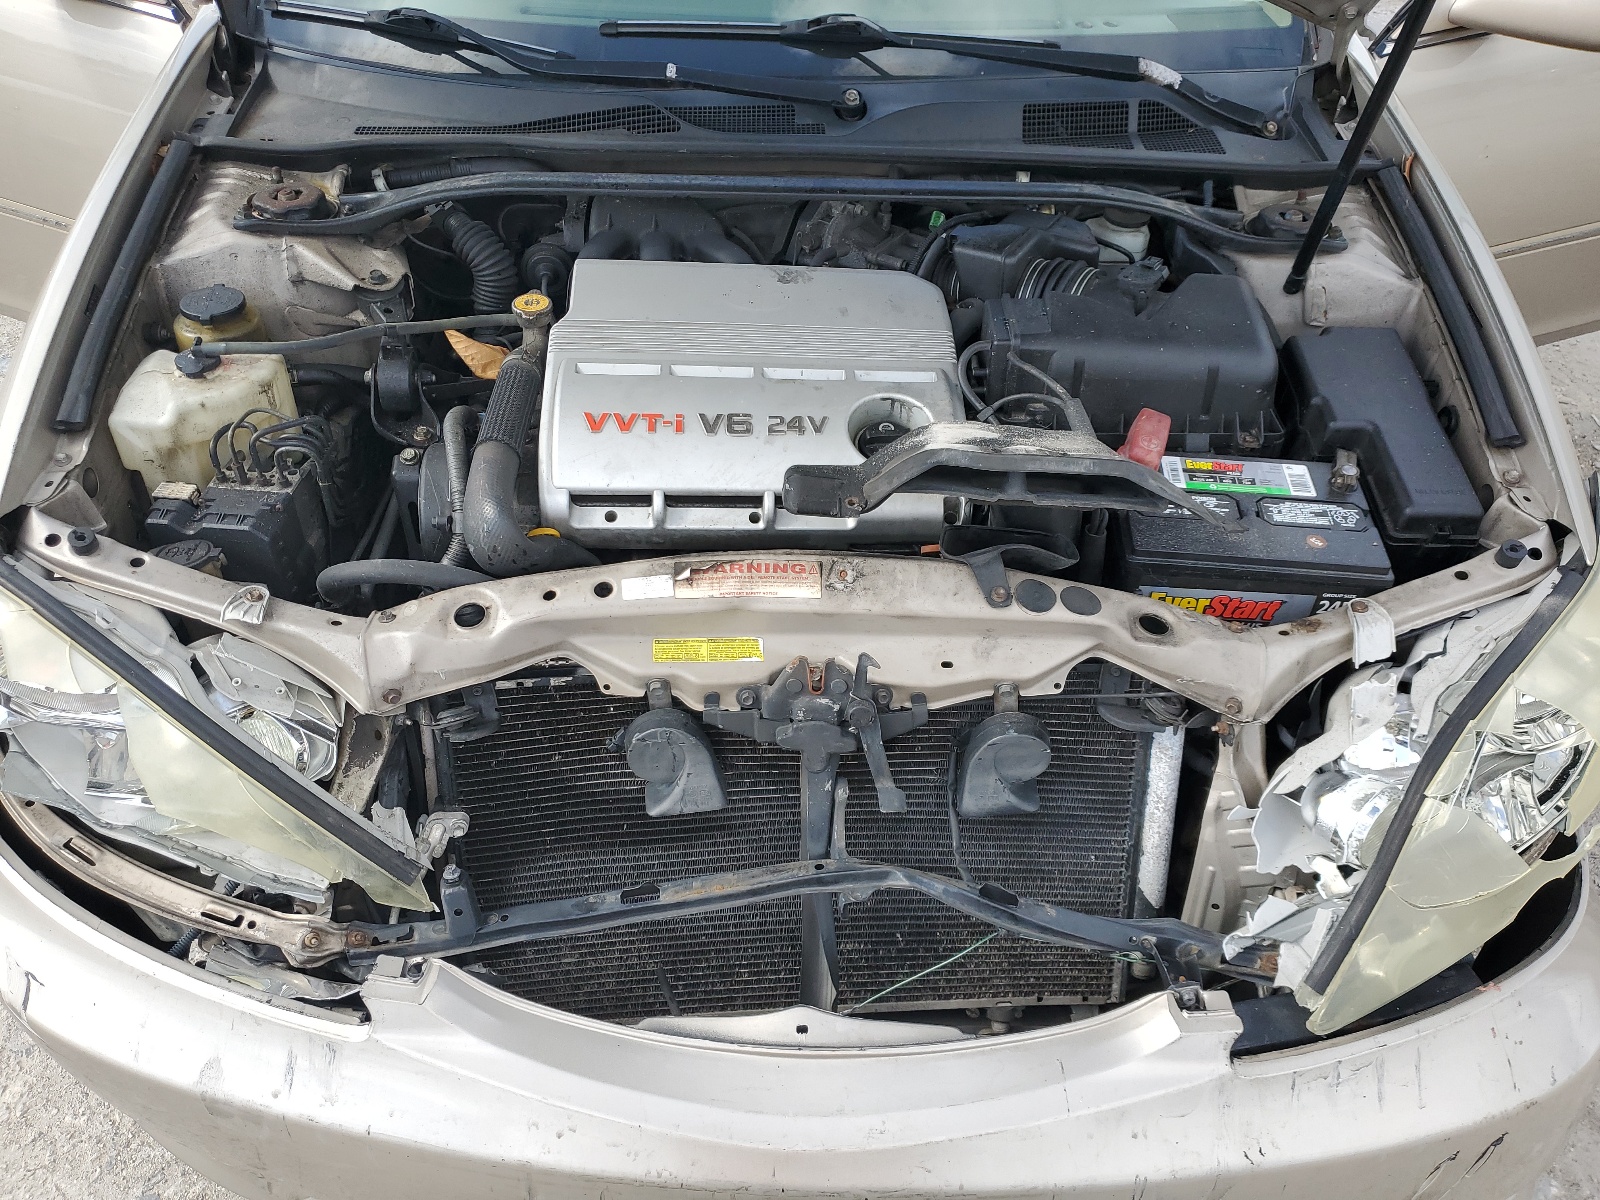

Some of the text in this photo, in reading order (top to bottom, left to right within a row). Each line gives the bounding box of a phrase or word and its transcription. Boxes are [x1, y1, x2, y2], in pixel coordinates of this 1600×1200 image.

[583, 411, 829, 437] VVT-i V6 24V
[1185, 459, 1244, 473] EverStart
[692, 562, 807, 575] ARNING
